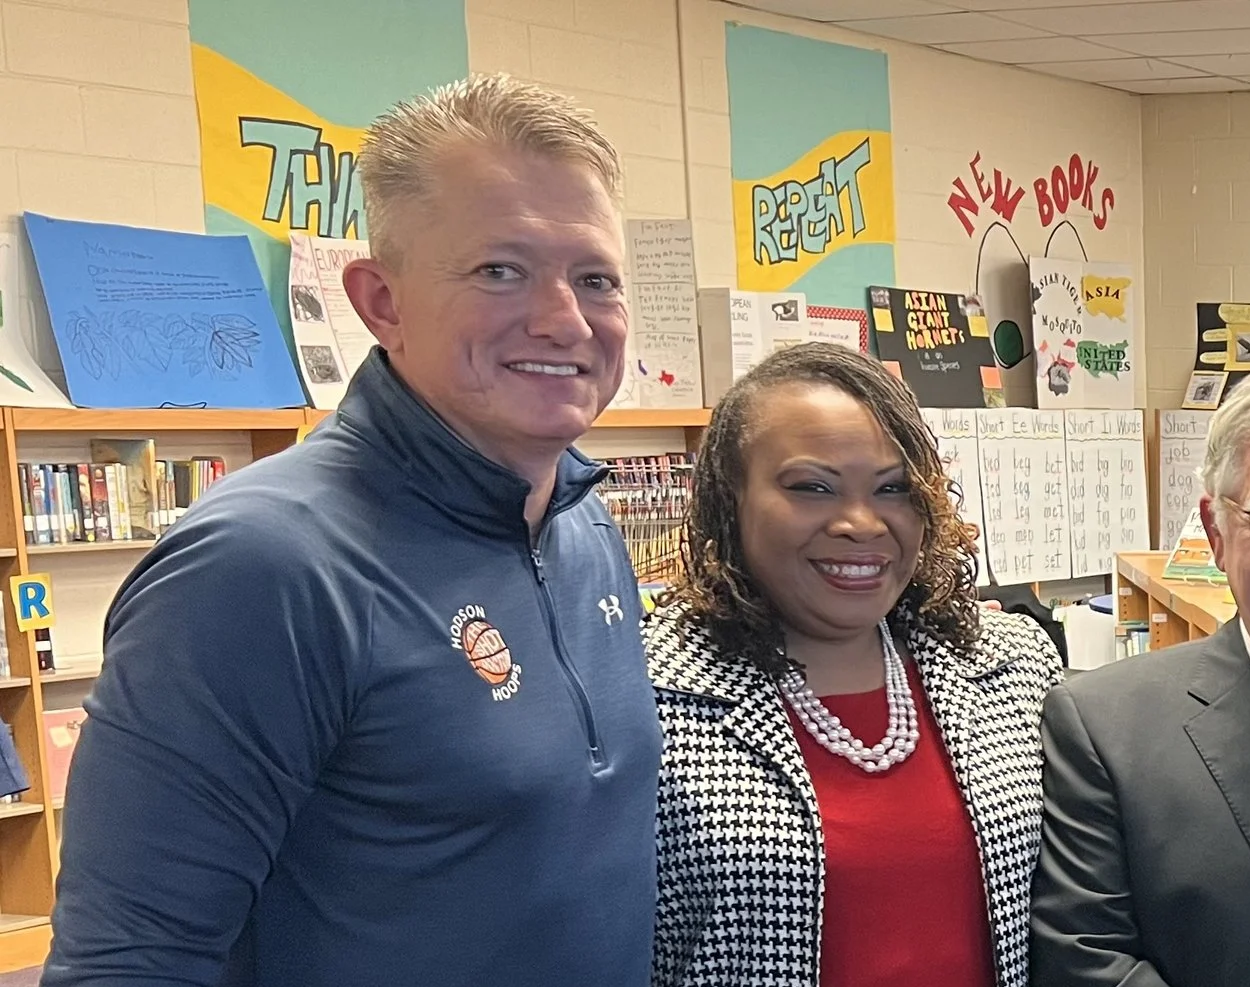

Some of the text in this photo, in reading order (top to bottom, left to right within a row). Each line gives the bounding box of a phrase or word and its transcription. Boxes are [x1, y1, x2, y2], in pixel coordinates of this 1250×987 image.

[752, 136, 871, 265] REPEAT
[947, 150, 1115, 238] NEW BOOKS
[1039, 272, 1060, 290] SIAN
[905, 291, 948, 311] ASIAN
[1085, 285, 1121, 302] ASIA
[907, 311, 950, 332] GIANT
[1084, 360, 1132, 373] STATES
[942, 409, 970, 432] Words
[979, 413, 1060, 435] Short Ee Words
[1067, 413, 1095, 435] Short
[1117, 414, 1141, 435] Words
[1164, 413, 1198, 435] Short
[1168, 467, 1194, 494] dog
[18, 581, 50, 621] R
[450, 604, 486, 650] HODSON
[491, 663, 522, 701] HOOPS
